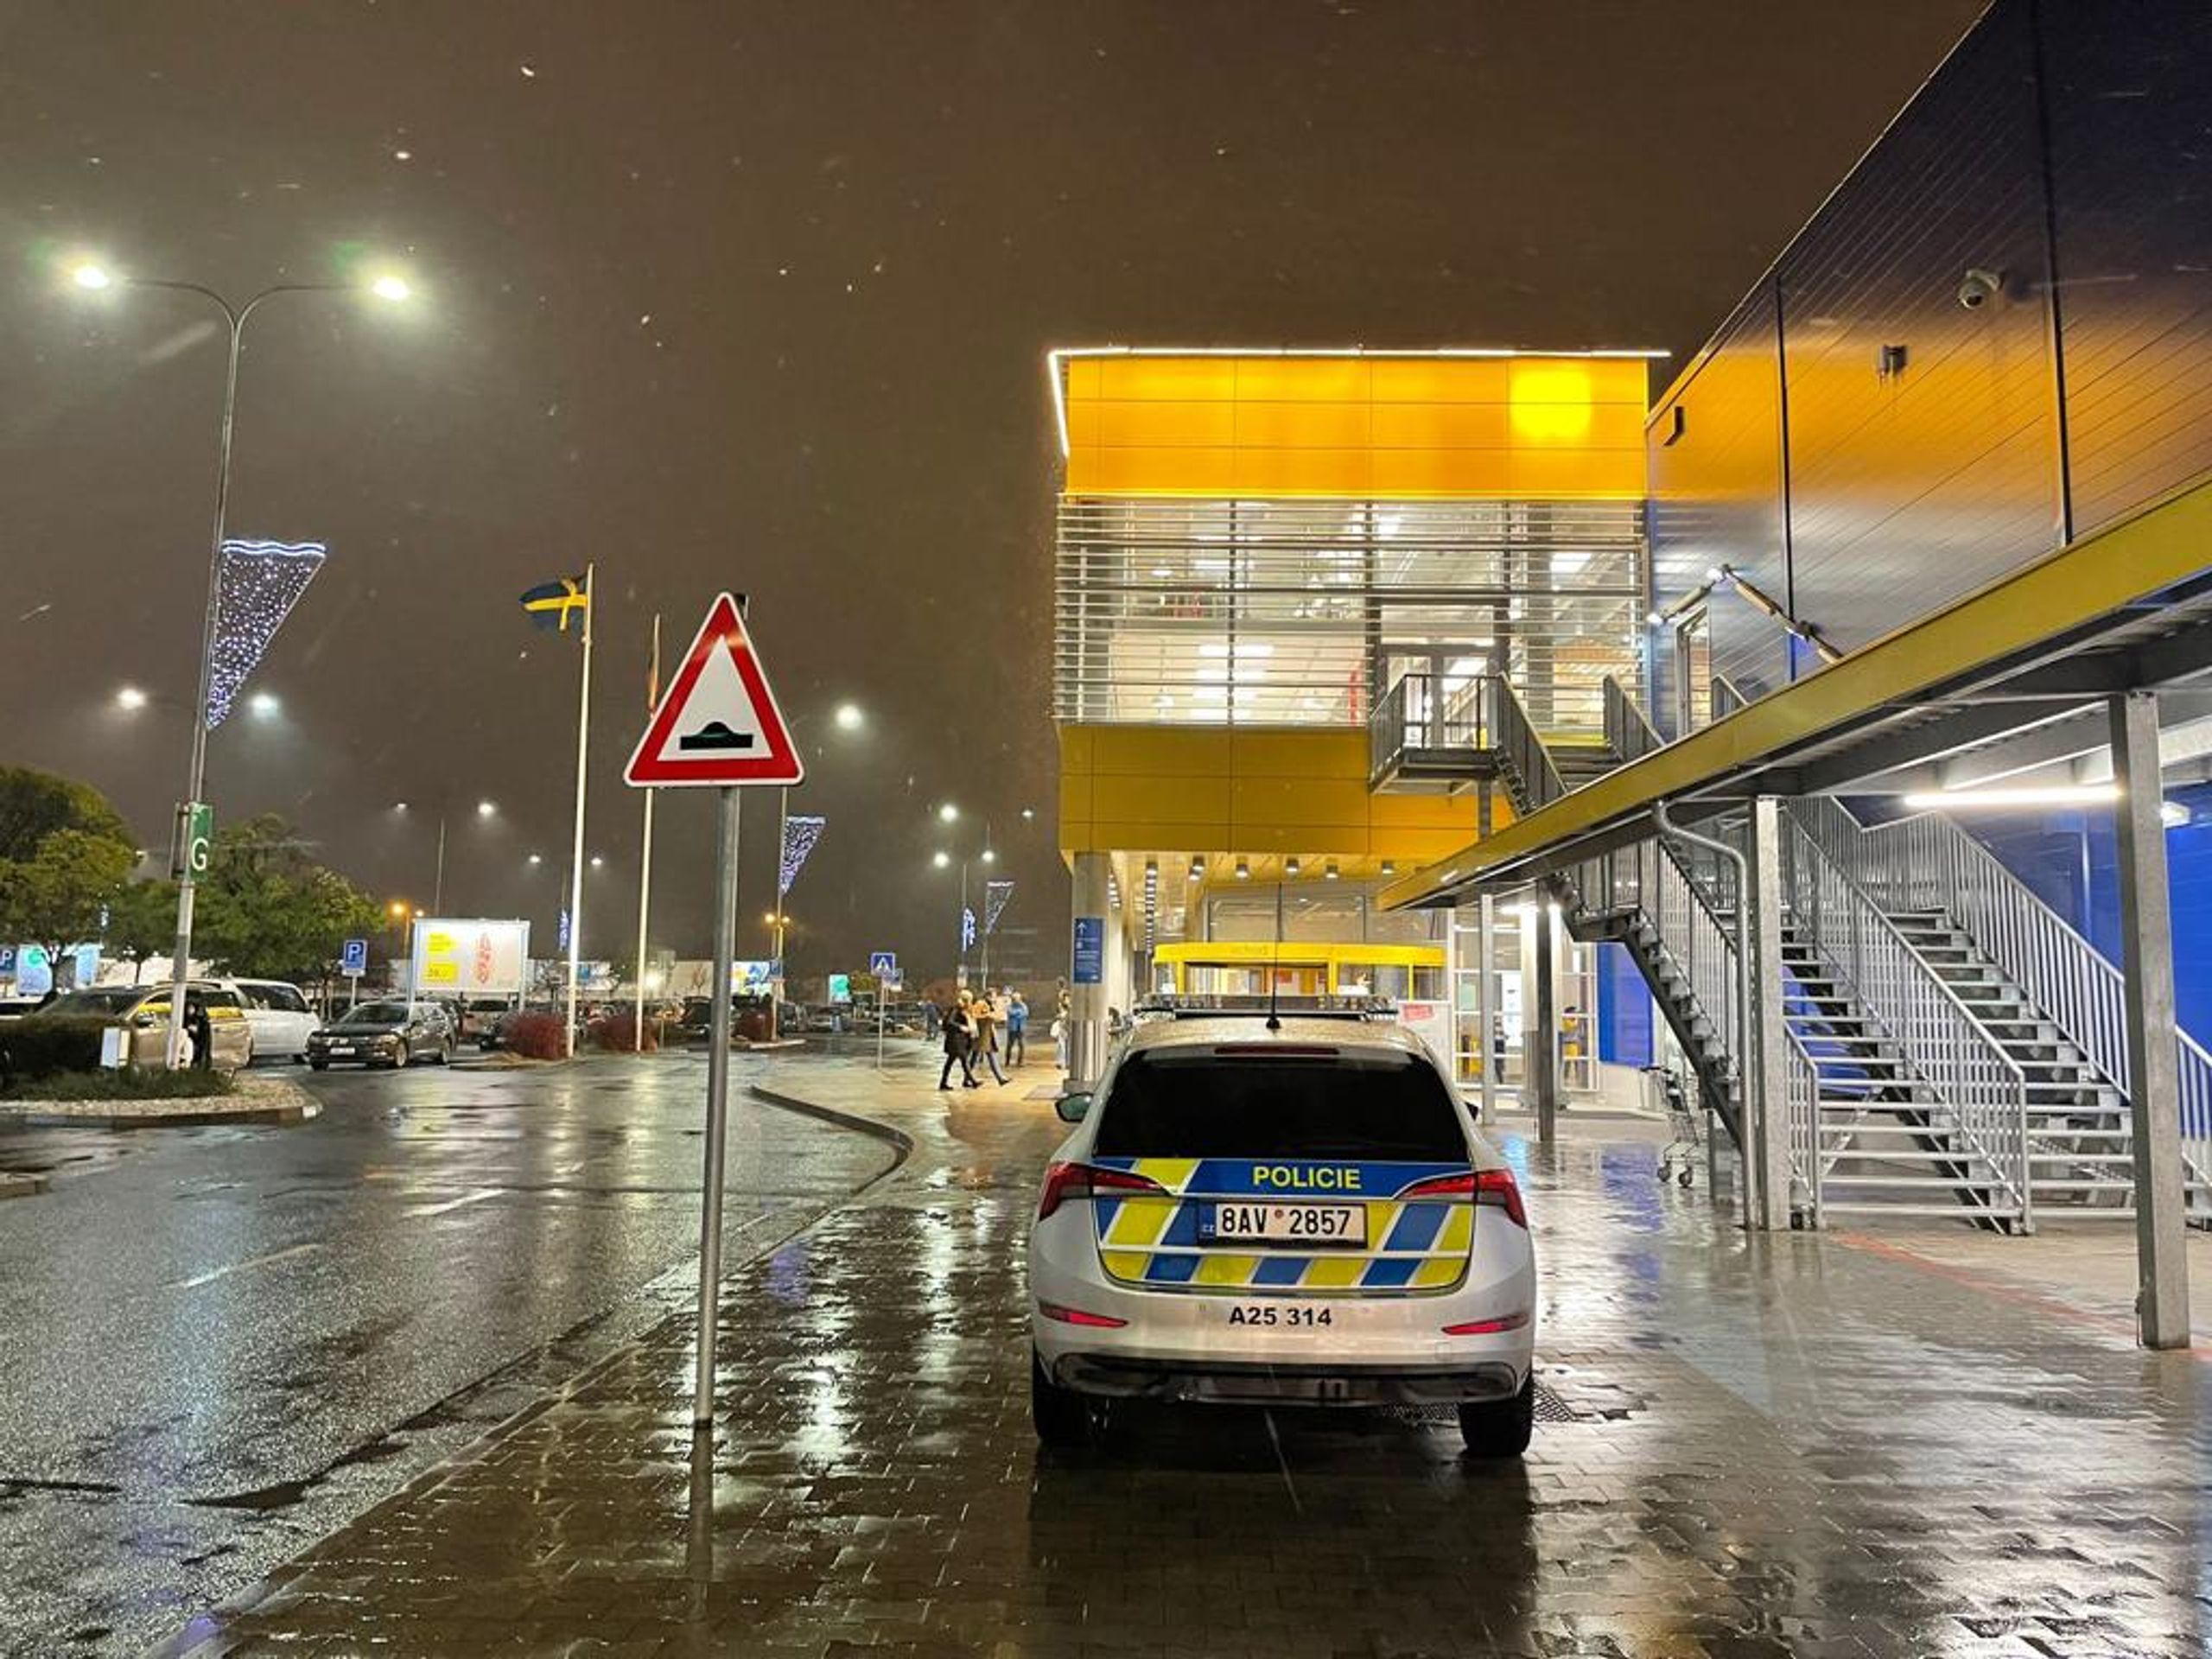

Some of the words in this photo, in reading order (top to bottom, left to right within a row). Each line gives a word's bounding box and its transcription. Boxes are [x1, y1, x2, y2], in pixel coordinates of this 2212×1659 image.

[192, 837, 209, 871] G
[347, 944, 361, 961] P
[1253, 1166, 1362, 1189] POLICIE
[1222, 1207, 1267, 1233] 8AV
[1289, 1209, 1351, 1235] 2857
[1229, 1306, 1277, 1325] A25
[1287, 1307, 1332, 1325] 314
